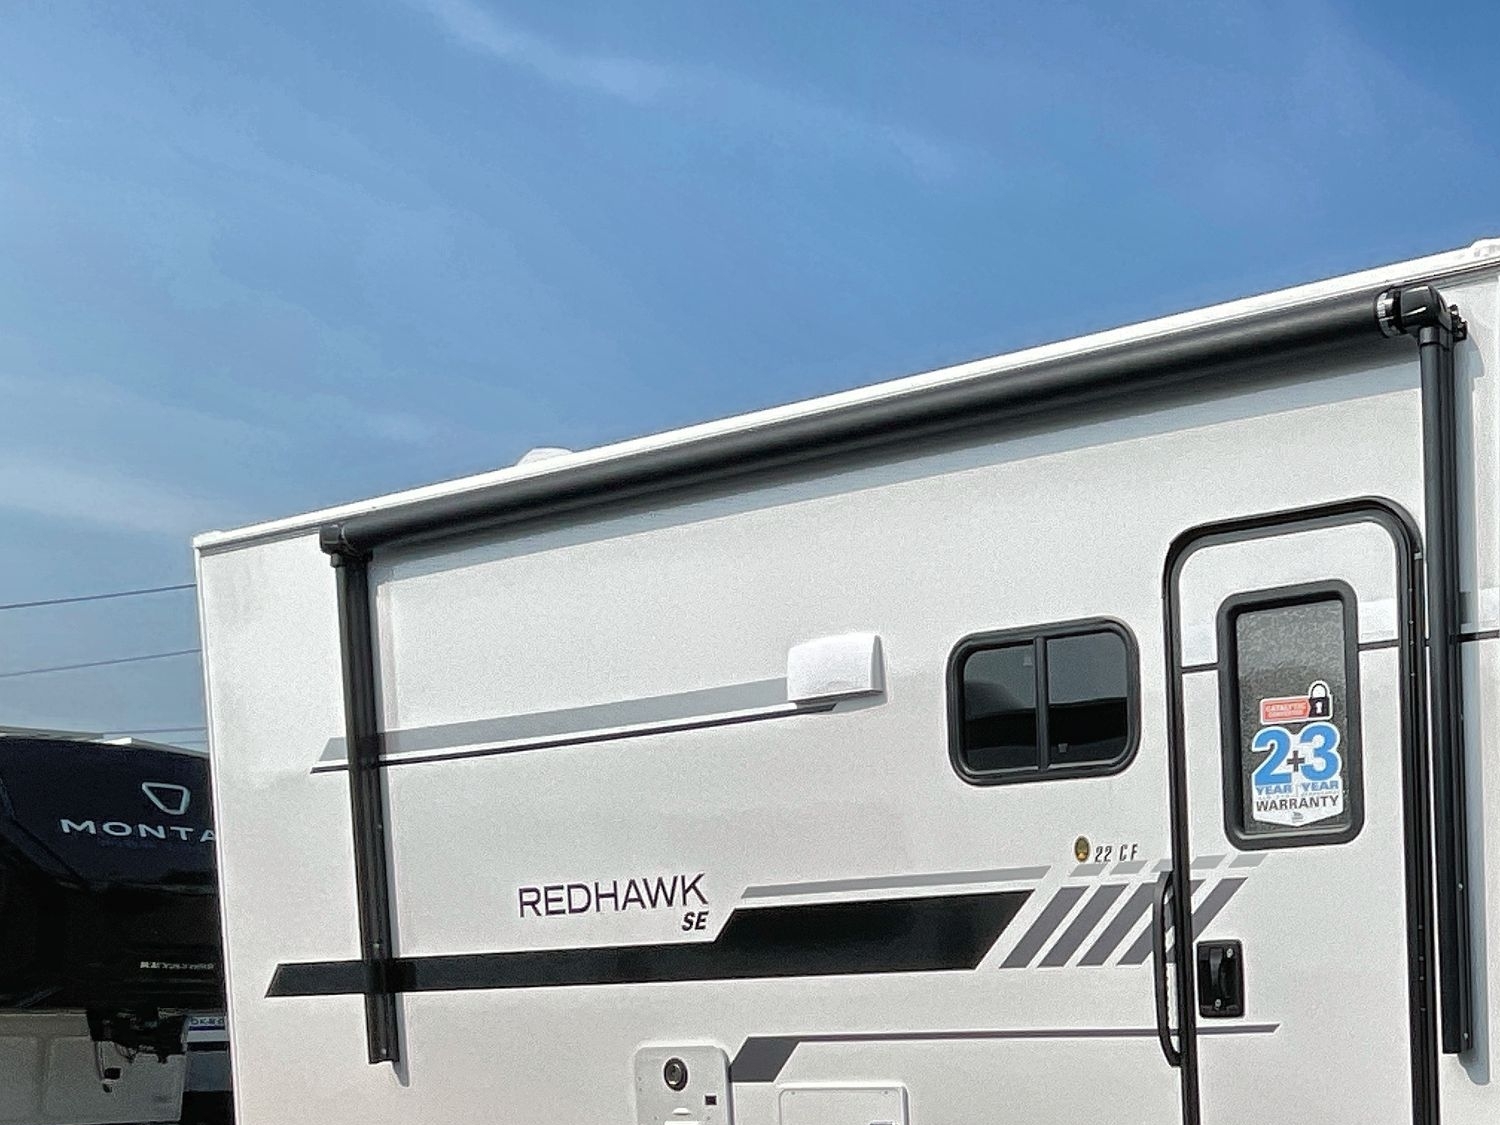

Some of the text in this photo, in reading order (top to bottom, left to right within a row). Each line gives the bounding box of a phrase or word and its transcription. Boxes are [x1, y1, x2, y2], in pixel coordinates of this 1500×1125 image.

[1256, 784, 1292, 796] YEAR
[1301, 780, 1339, 792] YEAR
[1256, 795, 1339, 812] WARRANTY
[60, 819, 216, 843] MONTA
[1095, 845, 1112, 862] 22
[518, 873, 709, 918] REDHAWK
[682, 911, 709, 931] SE
